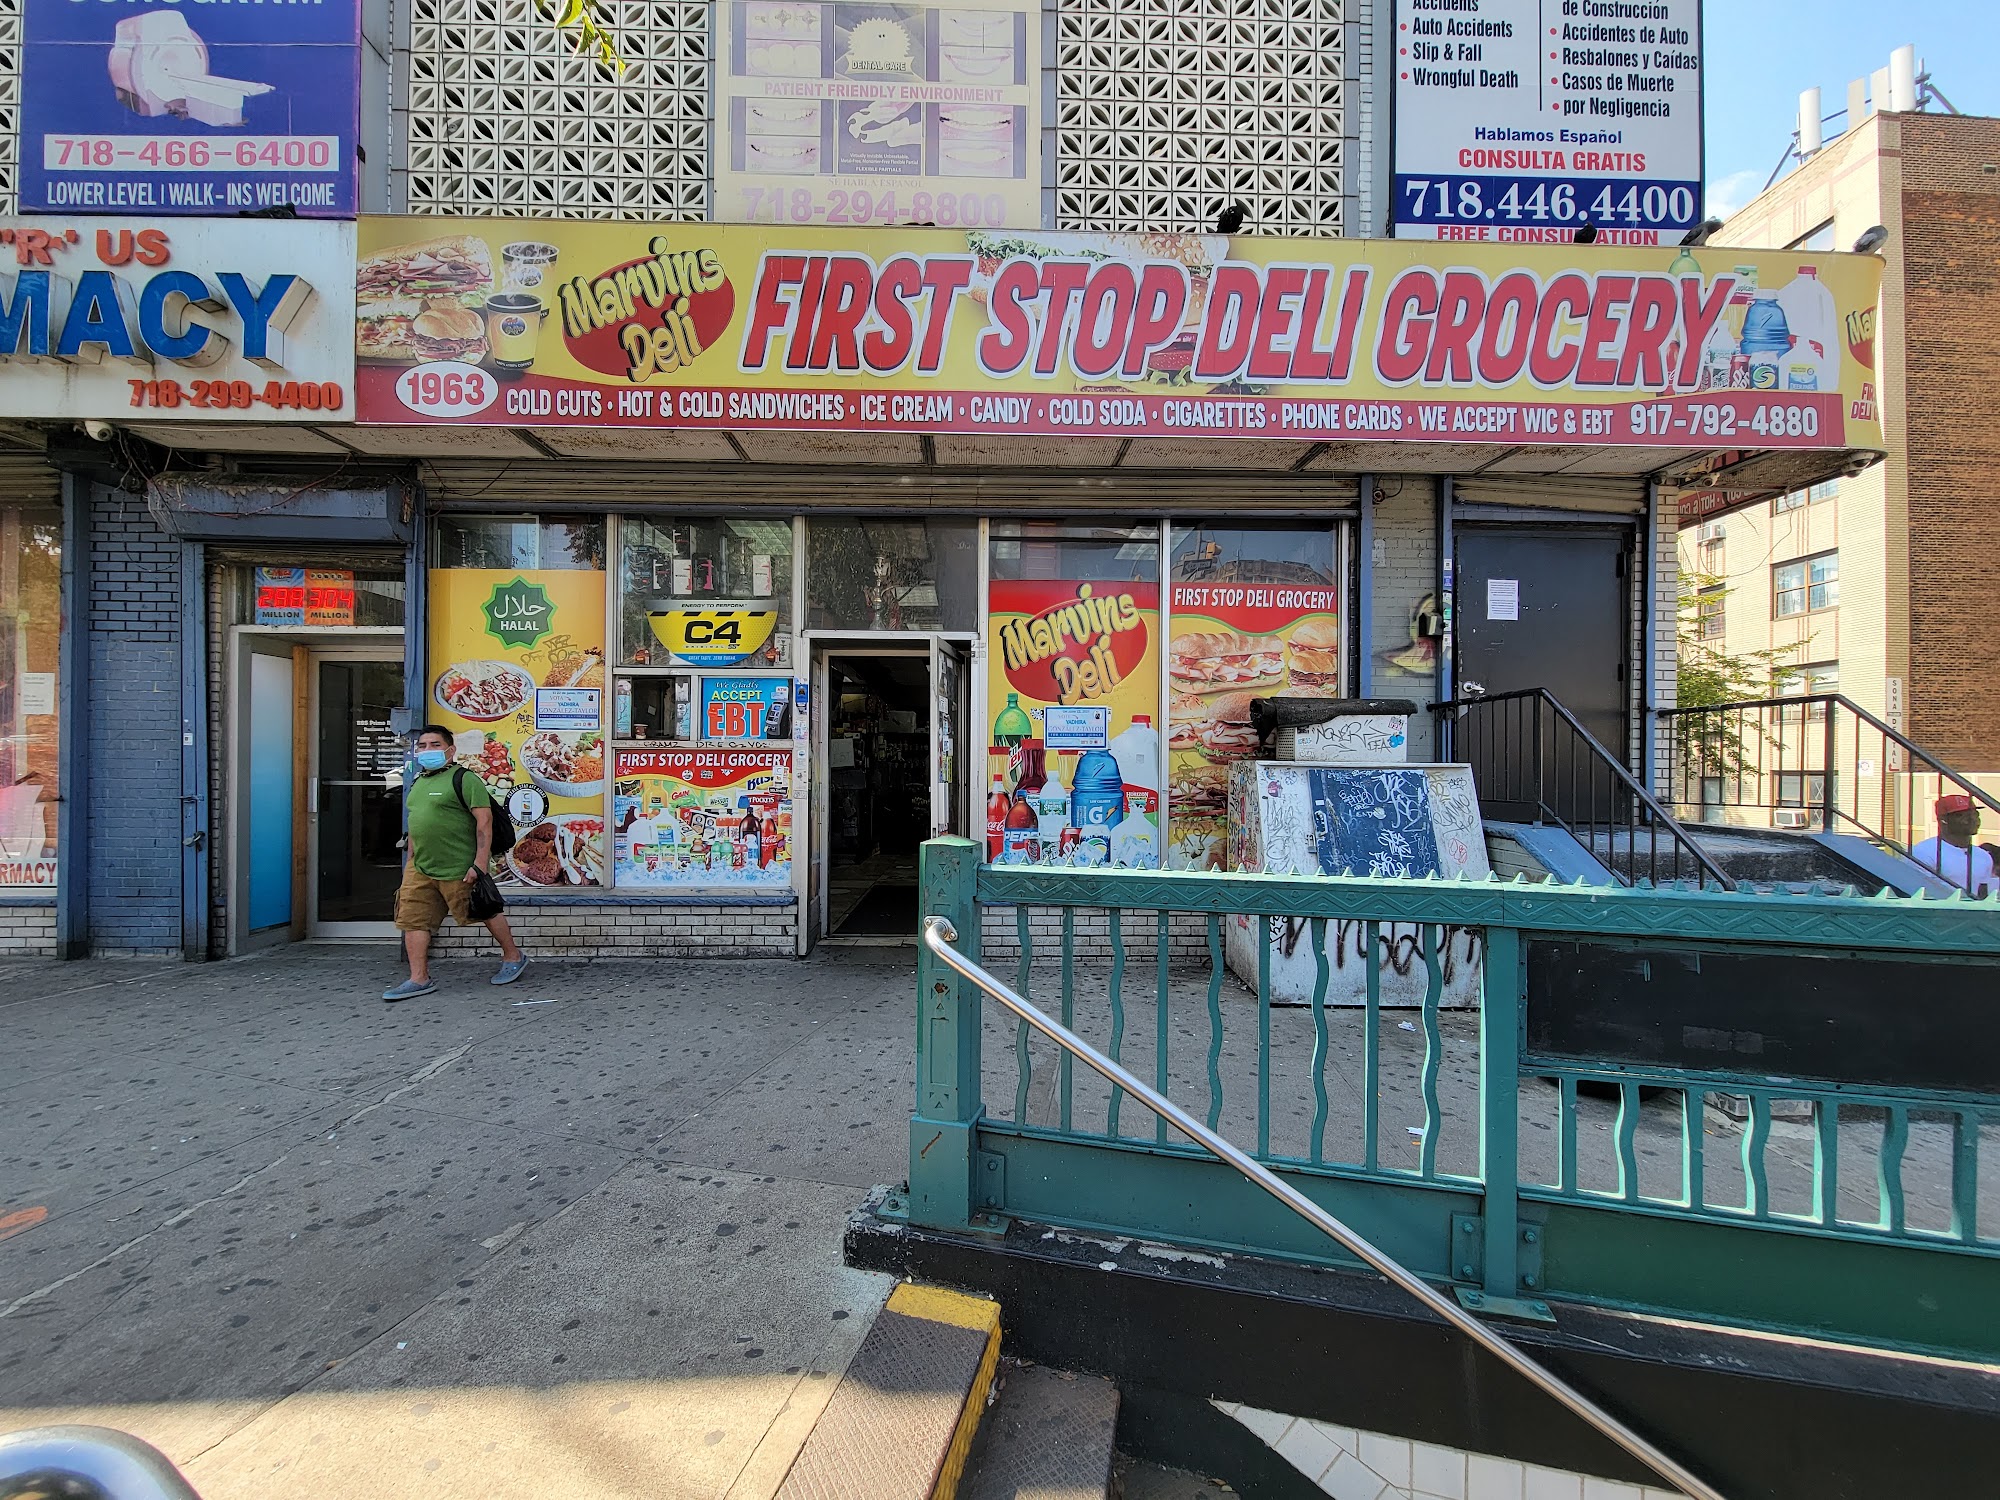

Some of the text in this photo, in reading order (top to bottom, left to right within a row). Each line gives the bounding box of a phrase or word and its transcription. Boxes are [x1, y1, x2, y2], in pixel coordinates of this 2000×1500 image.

[1562, 0, 1579, 15] de
[1412, 18, 1513, 38] Auto Accidents
[1562, 23, 1689, 45] Accidentes de Auto
[1412, 43, 1482, 62] Slip & Fall
[1562, 47, 1698, 70] Resbalones y Caídas
[851, 60, 906, 71] DENTAL CARE
[1412, 68, 1519, 89] Wrongful Death
[1562, 73, 1675, 92] Casos de Muerte
[763, 81, 1004, 103] PATIENT FRIENDLY ENVIRONMENT
[1563, 97, 1670, 119] por Negligencia
[1474, 126, 1622, 146] Hablamos Español
[54, 140, 330, 168] 718-466-6400
[1458, 148, 1646, 173] CONSULTA GRATIS
[47, 181, 105, 206] LOWER
[107, 182, 157, 206] LEVEL
[255, 182, 336, 207] WELCOME
[1404, 179, 1694, 223] 718.446.4400
[741, 186, 1007, 227] 718-294-8800
[1437, 225, 1659, 246] FREE CONSUATION
[96, 229, 170, 266] US
[560, 236, 727, 340] Marvins
[740, 253, 1740, 392] FIRST STOP DELI GROCERY
[619, 296, 704, 384] Deli
[128, 379, 343, 410] 718-299-4400
[406, 372, 486, 416] 1963
[506, 389, 1818, 437] COLD CUTS HOT & COLD SANDWICHES ICE CREAM CANDY COLD SODA CIGARETTES PHONE CARDS WE ACCEPT WIC & EBT 917-792-4880
[309, 587, 355, 609] 304
[493, 594, 546, 619] حلال
[1174, 588, 1335, 610] FIRST STOP DELI GROCERY
[500, 620, 540, 631] HALAL
[684, 620, 742, 644] C4
[1000, 582, 1142, 672] Marvins
[1050, 635, 1122, 705] Deli
[711, 690, 763, 701] ACCEPT
[716, 681, 759, 690] We Gladly
[708, 702, 766, 737] EBT
[619, 753, 790, 767] FIRST STOP DELI GROCERY
[1088, 806, 1103, 824] G
